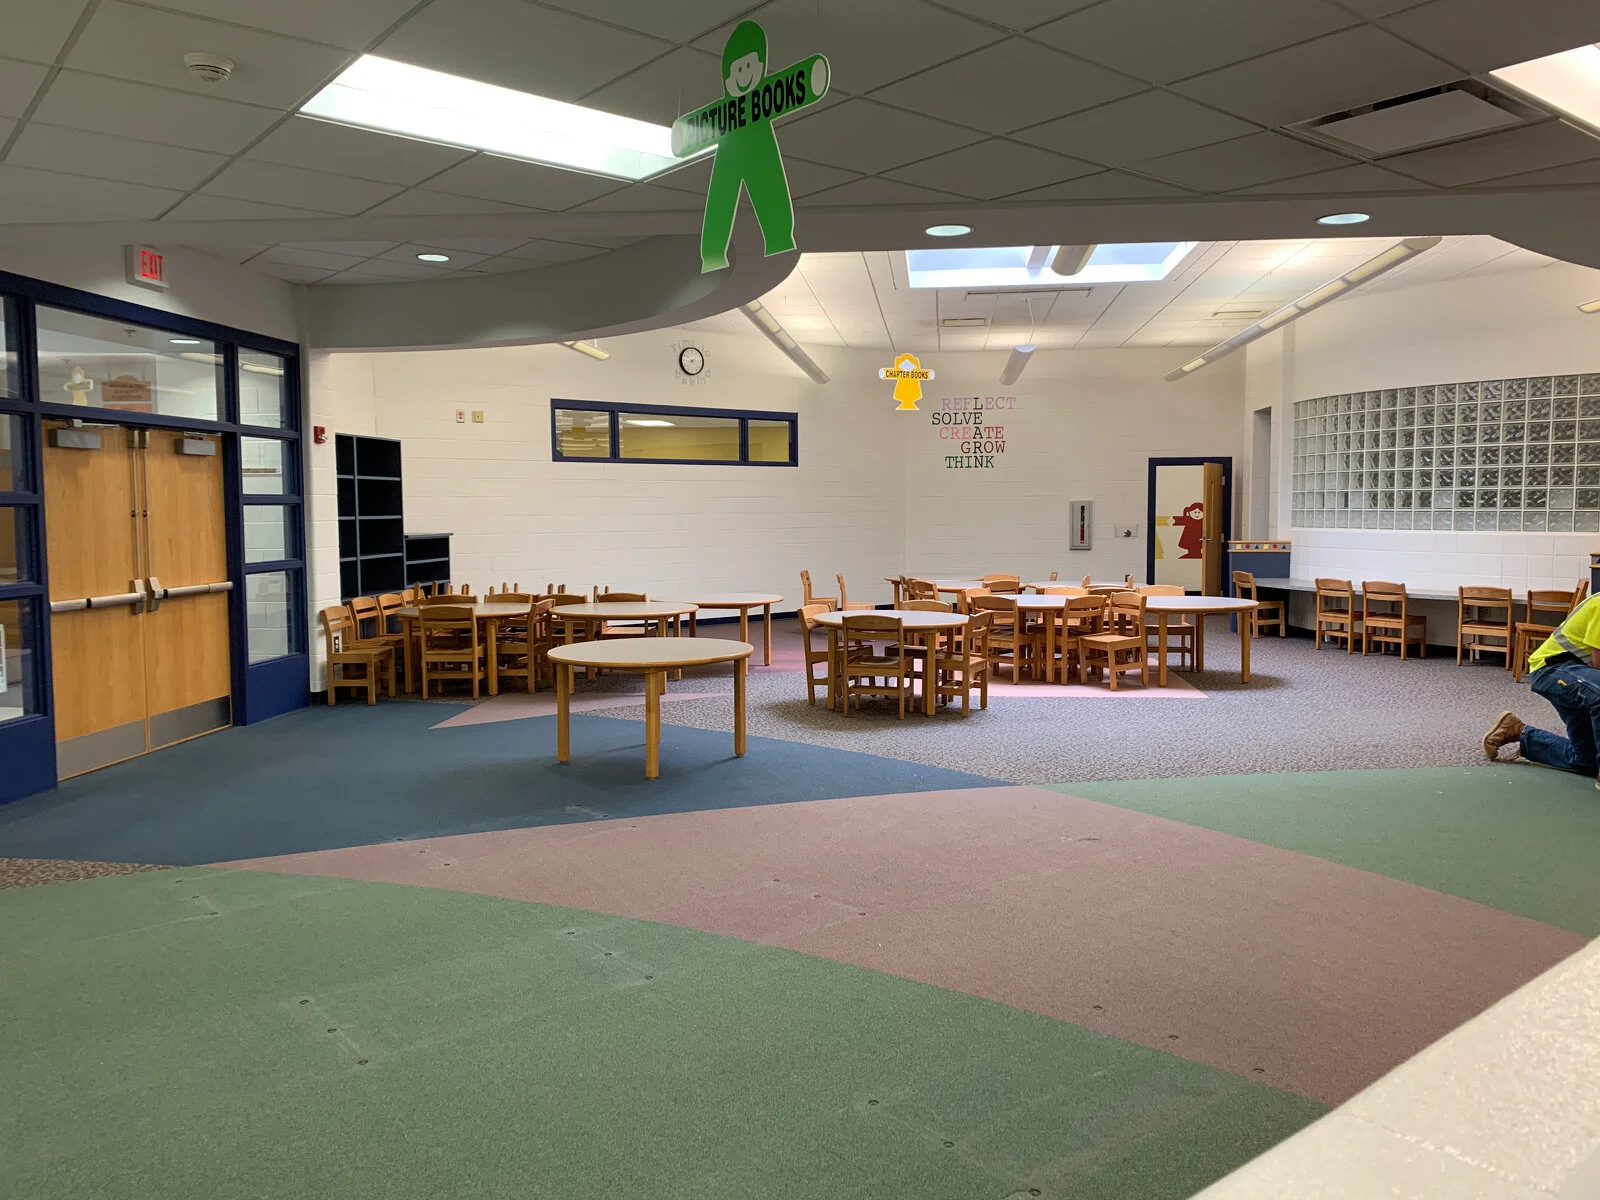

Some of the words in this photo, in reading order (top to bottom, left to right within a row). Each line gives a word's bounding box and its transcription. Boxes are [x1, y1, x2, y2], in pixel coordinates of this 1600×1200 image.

[687, 95, 747, 148] PICTURE
[751, 70, 806, 122] BOOKS
[141, 249, 163, 282] EXIT
[885, 370, 910, 379] CHAPTER
[911, 371, 929, 379] BOOKS
[942, 397, 1016, 410] REFLECT
[931, 412, 983, 425] SOLVE
[939, 426, 1004, 439] CREATE
[960, 441, 1006, 454] GROW
[944, 456, 995, 469] THINK
